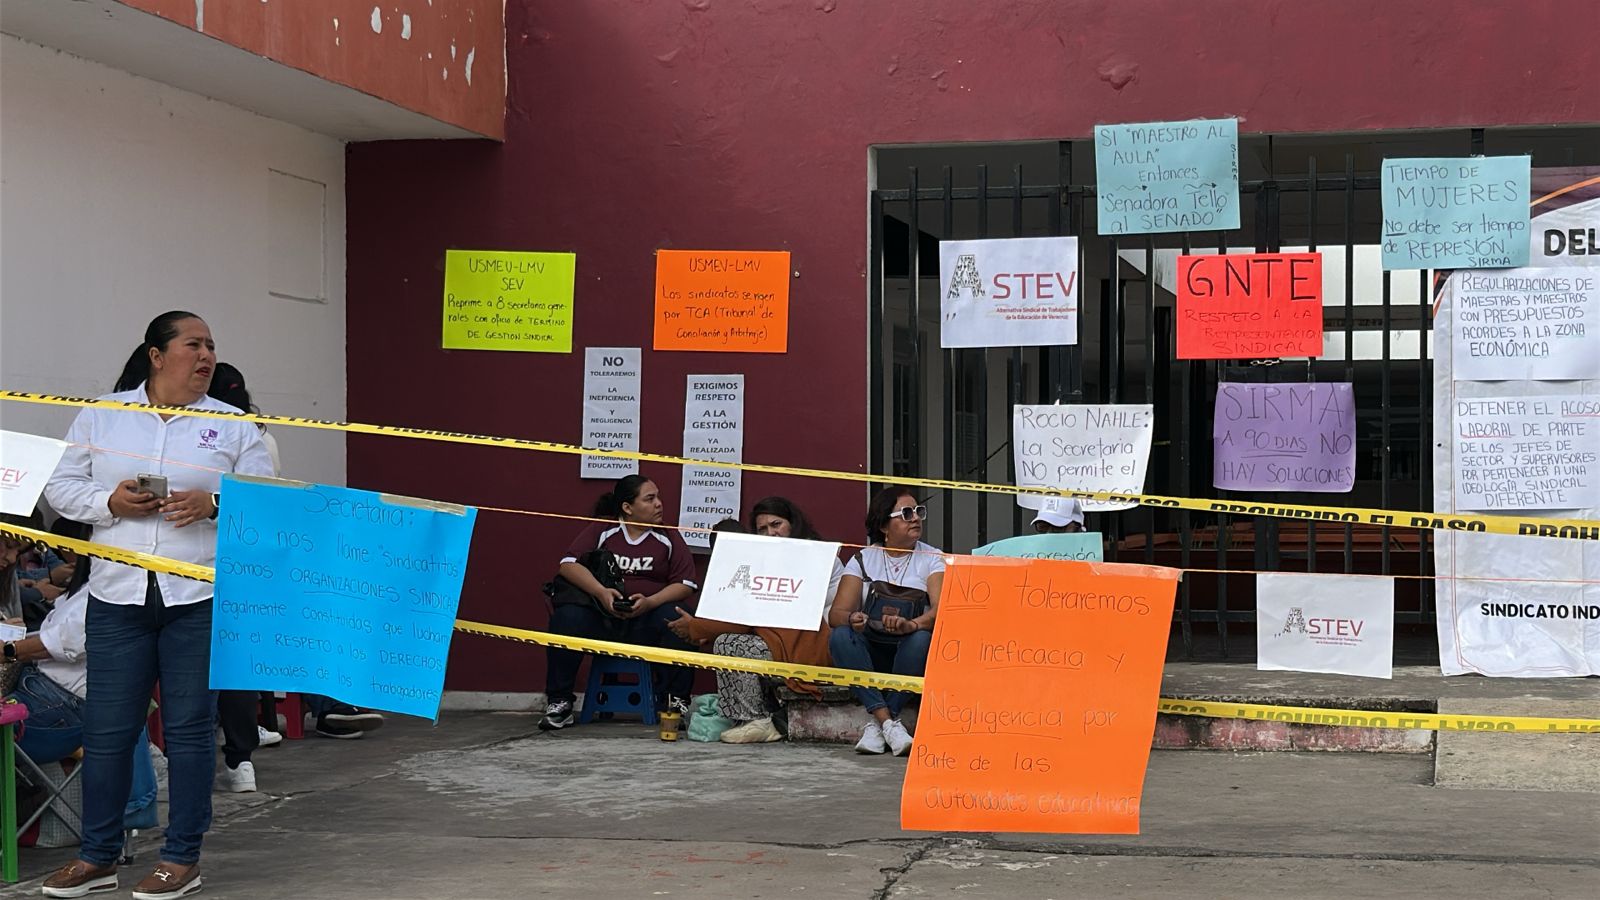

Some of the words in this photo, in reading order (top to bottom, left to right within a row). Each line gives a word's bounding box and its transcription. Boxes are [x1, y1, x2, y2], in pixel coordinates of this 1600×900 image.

[1101, 129, 1117, 146] SI
[1207, 125, 1230, 139] AL
[1139, 165, 1200, 181] Entonces
[1386, 165, 1448, 183] TIEMPO
[1459, 166, 1479, 178] DE
[1397, 181, 1518, 208] MUJERES
[1111, 216, 1128, 233] al
[1409, 220, 1440, 234] debe
[1452, 222, 1473, 234] ser
[1480, 213, 1525, 239] tiempo
[1384, 239, 1398, 253] de
[1544, 228, 1600, 256] DEL
[1468, 257, 1511, 267] SIRMA
[501, 277, 525, 291] SEV
[947, 254, 1076, 299] ASTEV
[1187, 258, 1316, 301] GNTE
[1575, 277, 1595, 291] DE
[662, 285, 681, 299] Los
[689, 285, 739, 300] sindicatos
[1460, 295, 1521, 308] MAESTRAS
[1523, 294, 1531, 305] Y
[1533, 293, 1588, 305] MAESTROS
[496, 296, 505, 309] 8
[514, 316, 523, 324] de
[664, 311, 681, 323] por
[685, 306, 710, 319] TCA
[761, 307, 774, 319] de
[1460, 312, 1480, 322] CON
[1484, 306, 1584, 323] PRESUPUESTOS
[468, 330, 480, 339] DE
[1462, 326, 1517, 340] ACORDES
[1523, 325, 1531, 339] A
[1536, 325, 1551, 338] LA
[1555, 323, 1586, 336] ZONA
[1212, 342, 1305, 354] SINDICAL
[1470, 339, 1550, 357] ECONÓMICA
[602, 356, 625, 367] NO
[693, 382, 739, 390] EXIGIMOS
[695, 393, 736, 401] RESPETO
[1223, 383, 1345, 428] SIRMA
[713, 410, 726, 418] LA
[1458, 401, 1526, 416] DETENER
[1534, 401, 1554, 415] EL
[1561, 400, 1600, 415] ACOSO
[692, 420, 736, 429] GESTIÓN
[1459, 422, 1516, 437] LABORAL
[1522, 423, 1543, 436] DE
[1548, 422, 1586, 436] PARTE
[1221, 430, 1233, 446] A
[1245, 428, 1271, 449] 90
[1274, 436, 1308, 450] DIAS
[1320, 431, 1352, 455] NO
[1461, 442, 1476, 453] DE
[1481, 443, 1504, 453] LOS
[1512, 441, 1552, 453] JEFES
[1556, 440, 1572, 451] DE
[1462, 455, 1504, 467] SECTOR
[1510, 455, 1518, 465] Y
[1522, 452, 1597, 465] SUPERVISORES
[1022, 460, 1047, 480] NO
[1057, 459, 1113, 482] permite
[1120, 459, 1136, 476] el
[1223, 462, 1256, 483] HAY
[1267, 463, 1353, 485] SOLUCIONES
[1462, 469, 1479, 480] POR
[1483, 466, 1549, 480] PERTENECER
[1554, 467, 1560, 475] A
[1563, 465, 1587, 476] UNA
[1525, 478, 1588, 491] SINDICAL
[705, 496, 717, 504] EN
[1485, 490, 1568, 507] DIFERENTE
[686, 506, 734, 515] BENEFICIO
[693, 521, 705, 529] DE
[227, 511, 260, 546] No
[276, 530, 314, 553] nos
[337, 532, 369, 562] llame
[613, 554, 653, 571] OAZ
[289, 567, 401, 604] ORGANIZACIONES
[727, 564, 803, 594] ASTEV
[946, 565, 991, 604] No
[1015, 569, 1150, 616] toleraremos
[218, 594, 287, 620] legalmente
[382, 621, 403, 637] que
[1481, 602, 1570, 619] SINDICATO
[1572, 604, 1600, 620] IND
[1282, 607, 1364, 637] ASTEV
[218, 628, 241, 646] por
[249, 630, 261, 643] el
[275, 633, 333, 654] RESPETO
[349, 645, 367, 661] los
[379, 649, 443, 673] DERECHOS
[935, 621, 960, 664] la
[979, 639, 1084, 667] ineficacia
[250, 655, 309, 679] laborales
[316, 668, 330, 680] de
[338, 671, 353, 688] los
[928, 689, 1063, 734] Negligencia
[1083, 706, 1119, 735] por
[916, 743, 957, 771] Parte
[969, 754, 990, 771] de
[1014, 751, 1052, 773] las
